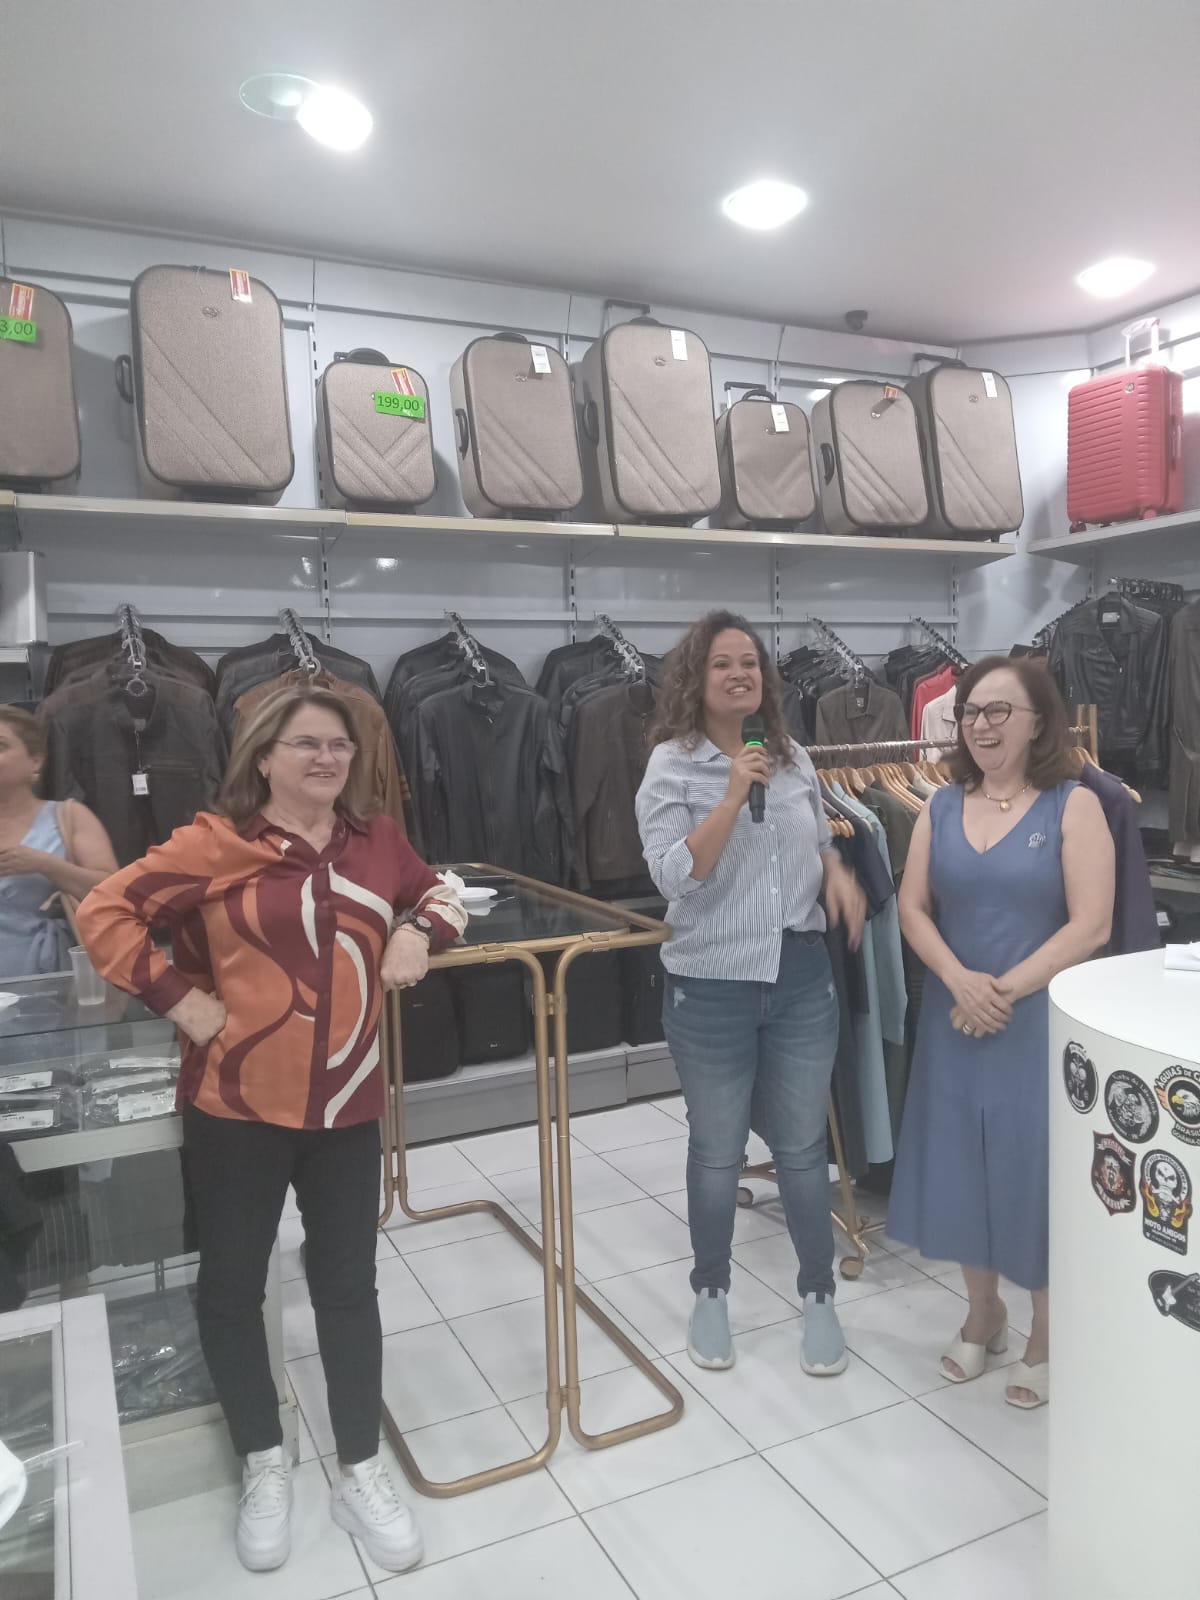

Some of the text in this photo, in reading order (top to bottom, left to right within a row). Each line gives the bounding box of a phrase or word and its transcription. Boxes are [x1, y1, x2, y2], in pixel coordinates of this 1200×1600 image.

[377, 395, 420, 411] 199,00
[1194, 1071, 1200, 1083] C
[1144, 1217, 1161, 1231] MOTO
[1160, 1225, 1185, 1242] AMIGOS
